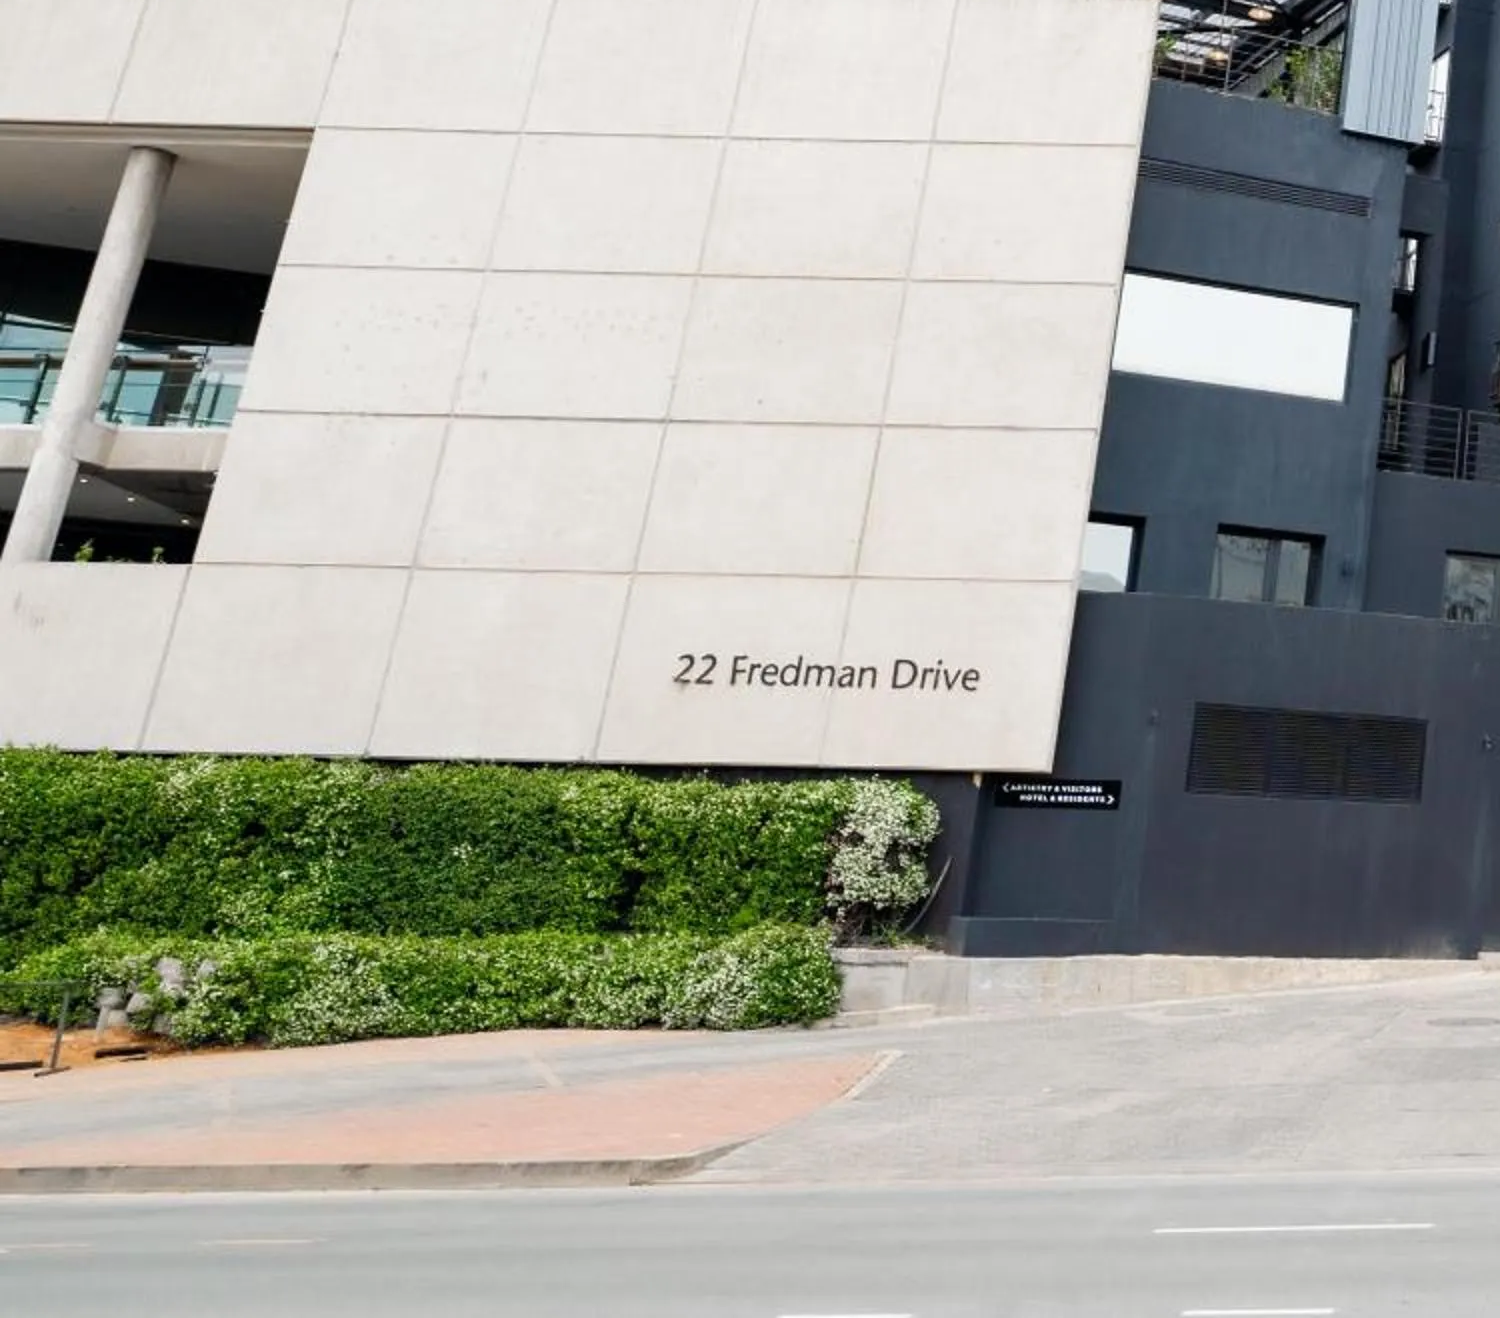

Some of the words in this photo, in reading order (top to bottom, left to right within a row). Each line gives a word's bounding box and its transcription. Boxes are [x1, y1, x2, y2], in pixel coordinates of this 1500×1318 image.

[673, 653, 718, 685] 22
[729, 655, 878, 689] Fredman
[891, 658, 980, 692] Drive
[1061, 785, 1103, 793] VISITORS
[1020, 794, 1048, 802] HOTEL
[1058, 795, 1106, 803] RESIDENTS
